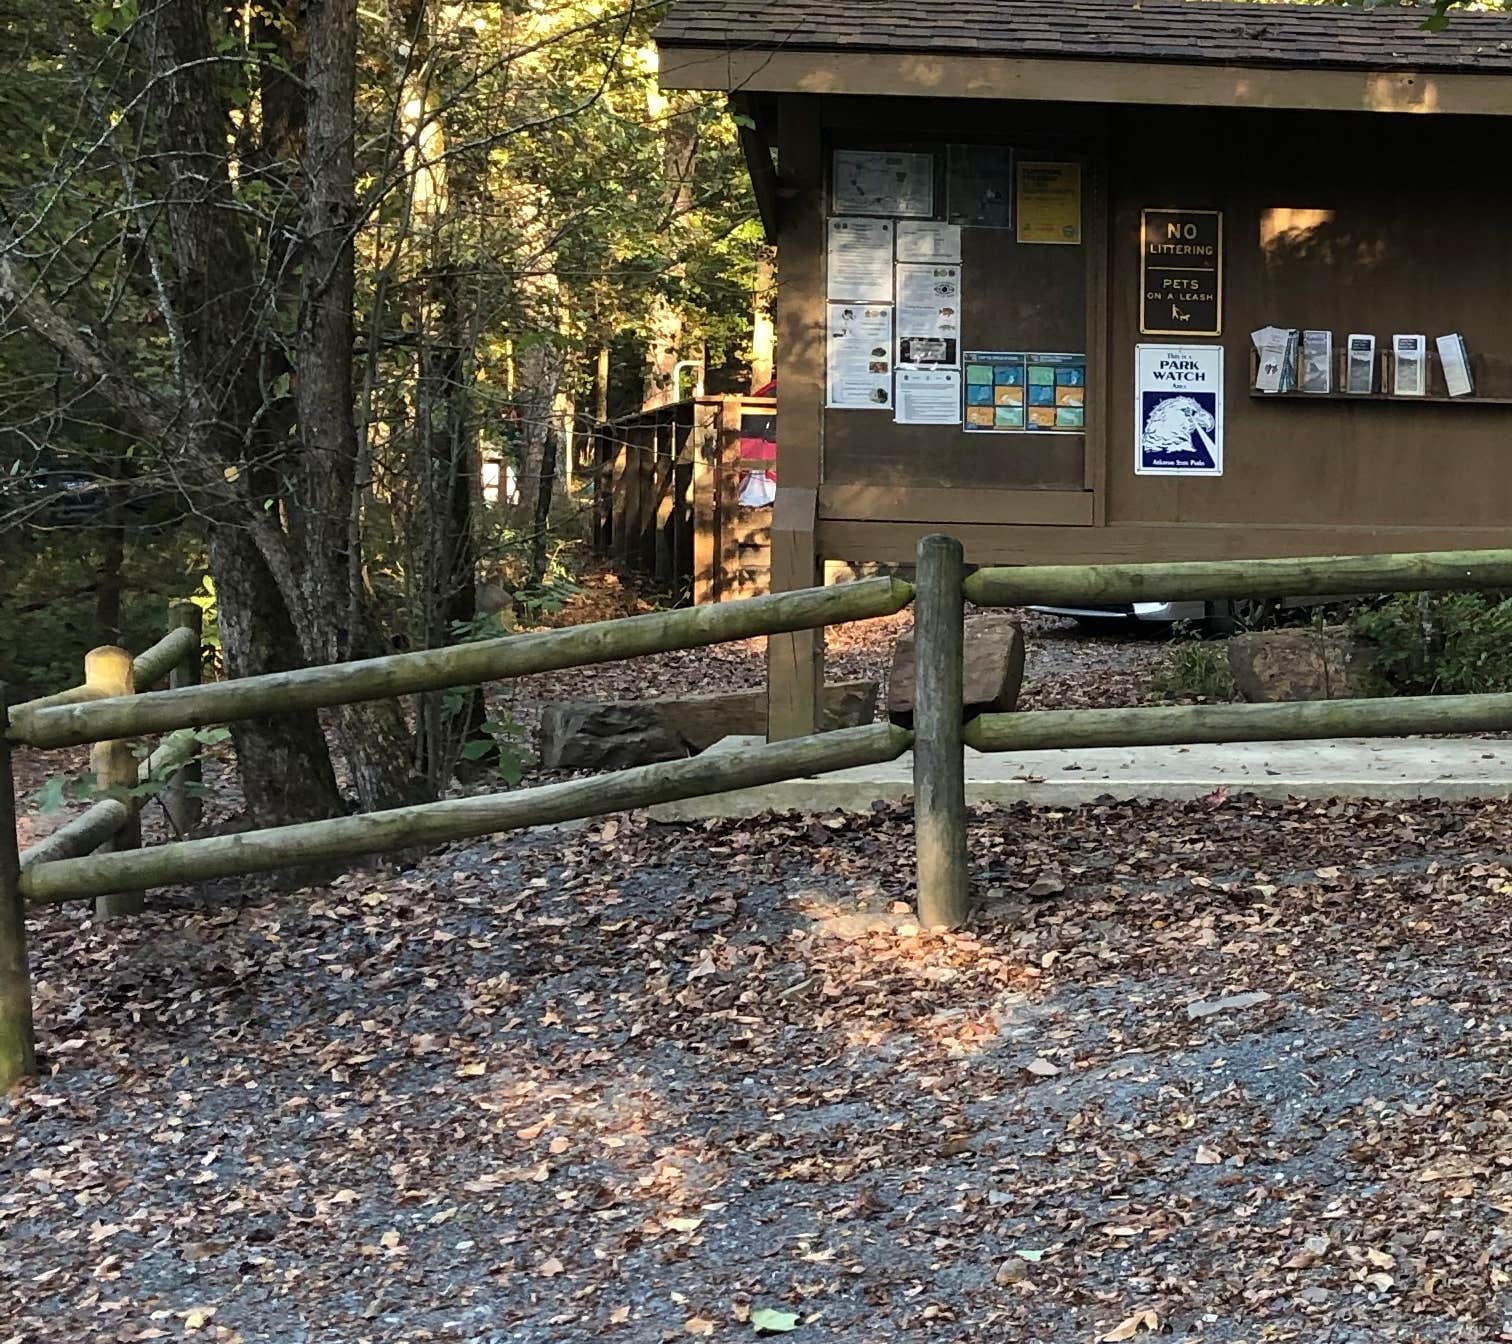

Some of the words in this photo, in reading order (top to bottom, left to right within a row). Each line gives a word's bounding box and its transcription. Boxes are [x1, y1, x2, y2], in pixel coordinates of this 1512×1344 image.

[1167, 222, 1198, 240] NO
[1149, 243, 1214, 256] LITTERING
[1163, 278, 1200, 290] PETS
[1146, 292, 1162, 300] ON
[1167, 292, 1175, 300] A
[1179, 293, 1213, 301] LEASH
[1159, 360, 1200, 370] PARK
[1152, 371, 1206, 382] WATCH
